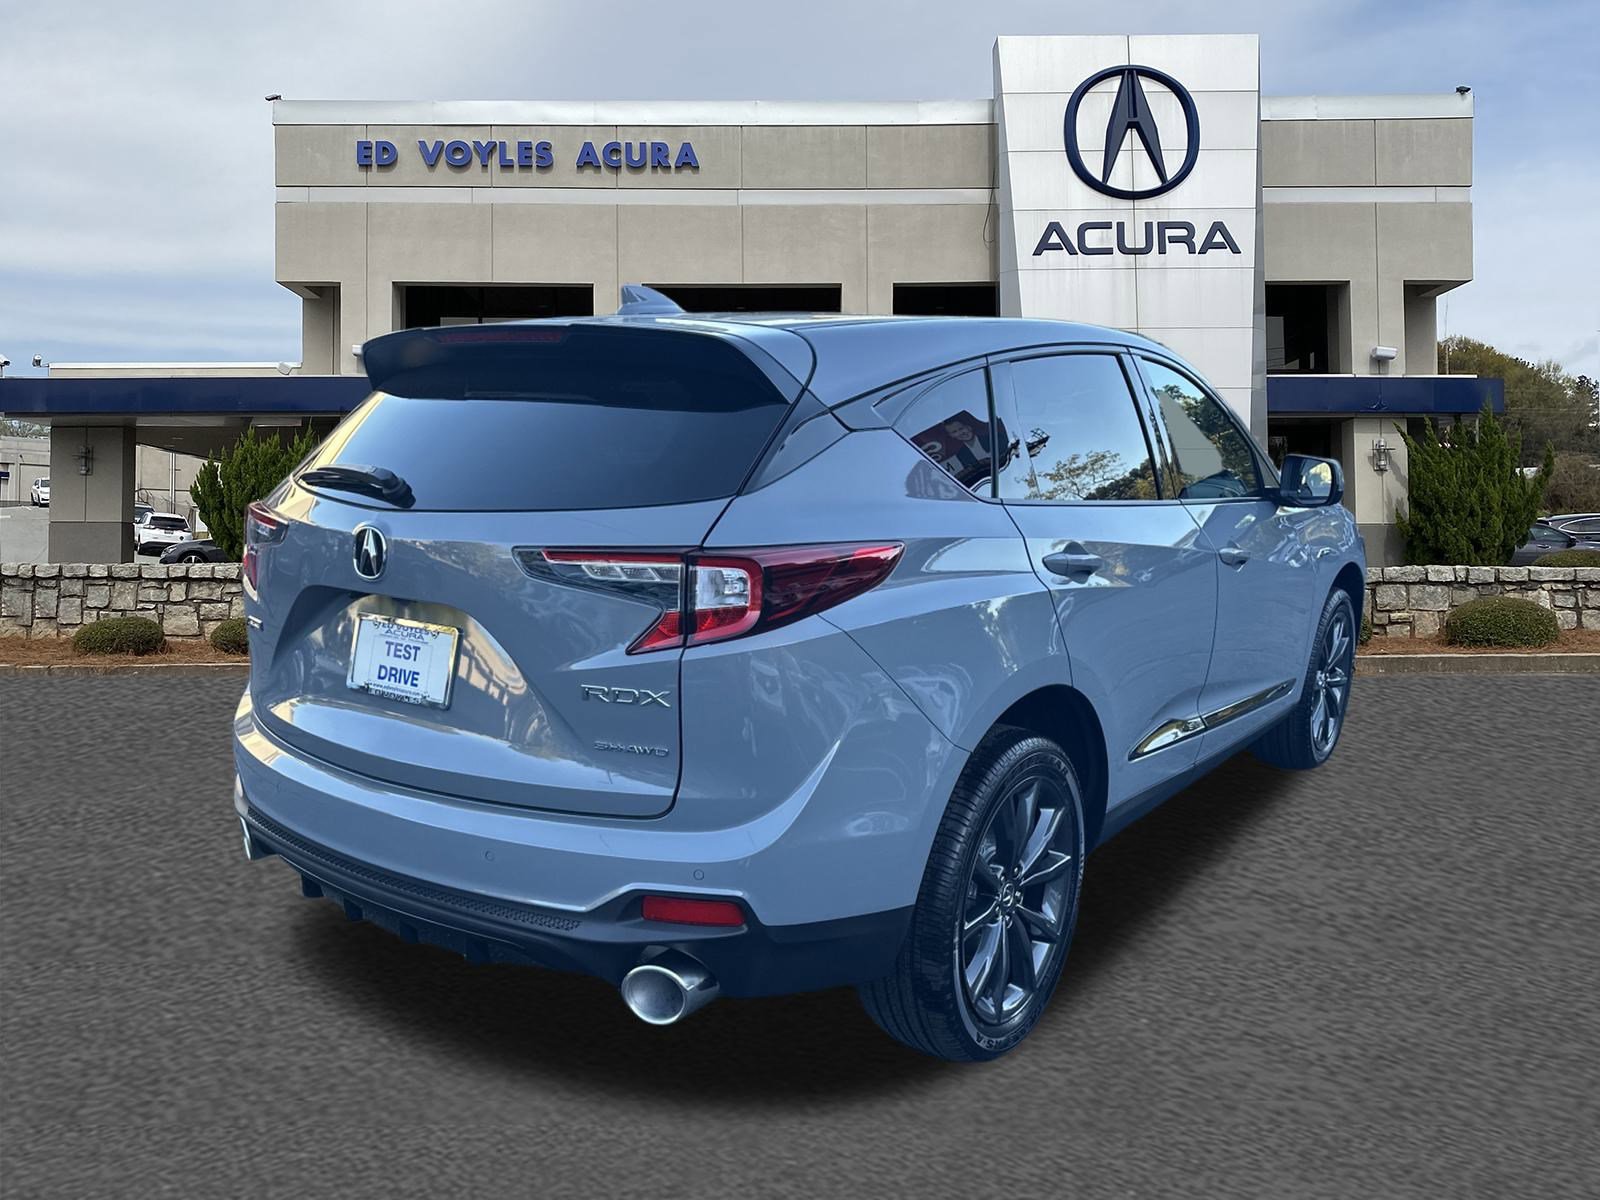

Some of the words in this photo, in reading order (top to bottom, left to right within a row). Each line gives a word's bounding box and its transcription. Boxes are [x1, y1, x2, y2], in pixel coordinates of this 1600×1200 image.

[356, 140, 398, 168] ED
[418, 140, 554, 169] VOYLES
[576, 141, 700, 170] ACURA
[1032, 220, 1242, 256] ACURA
[385, 640, 421, 662] TEST
[377, 664, 420, 688] DRIVE
[580, 684, 671, 707] RDX
